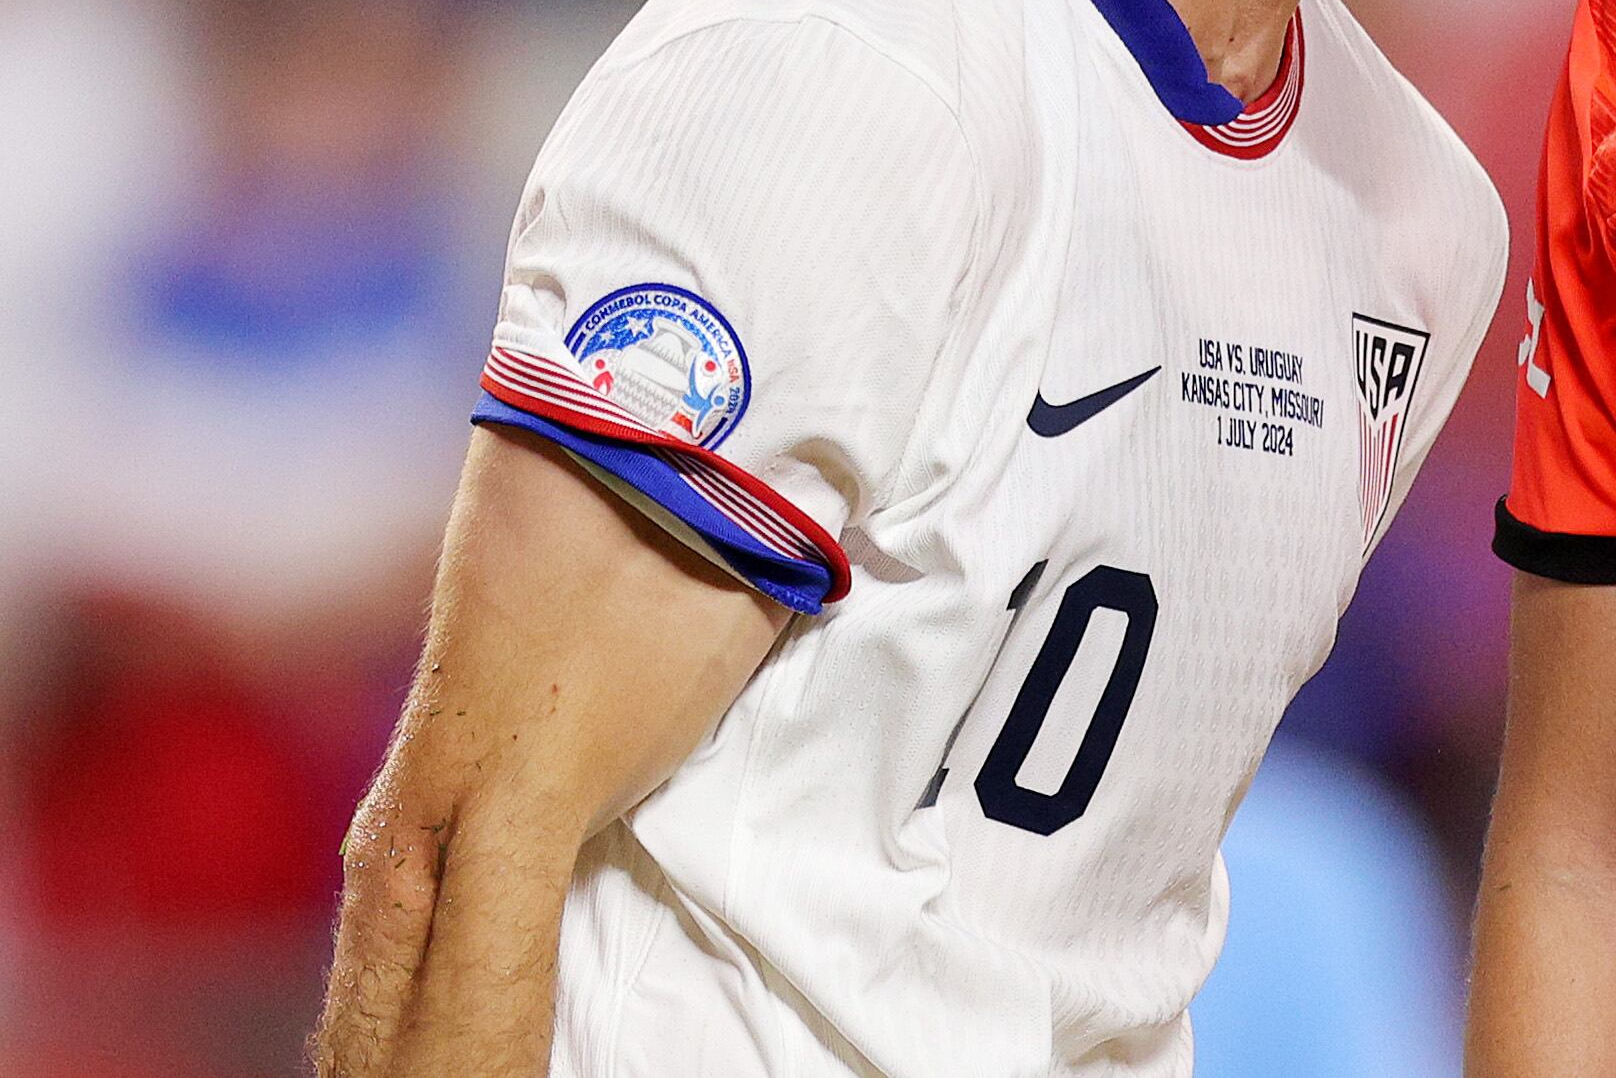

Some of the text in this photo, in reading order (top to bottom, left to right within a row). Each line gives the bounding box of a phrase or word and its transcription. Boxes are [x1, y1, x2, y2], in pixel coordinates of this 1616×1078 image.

[585, 294, 652, 332] CONMEBOL
[653, 294, 687, 312] COPA
[689, 309, 732, 357] AMERICA
[1199, 338, 1303, 385] USA VS. URUGUAY
[1355, 330, 1416, 421] USA
[1181, 372, 1324, 429] KANSAS CITY, MISSOURI
[1217, 416, 1293, 456] 1 JULY 2024
